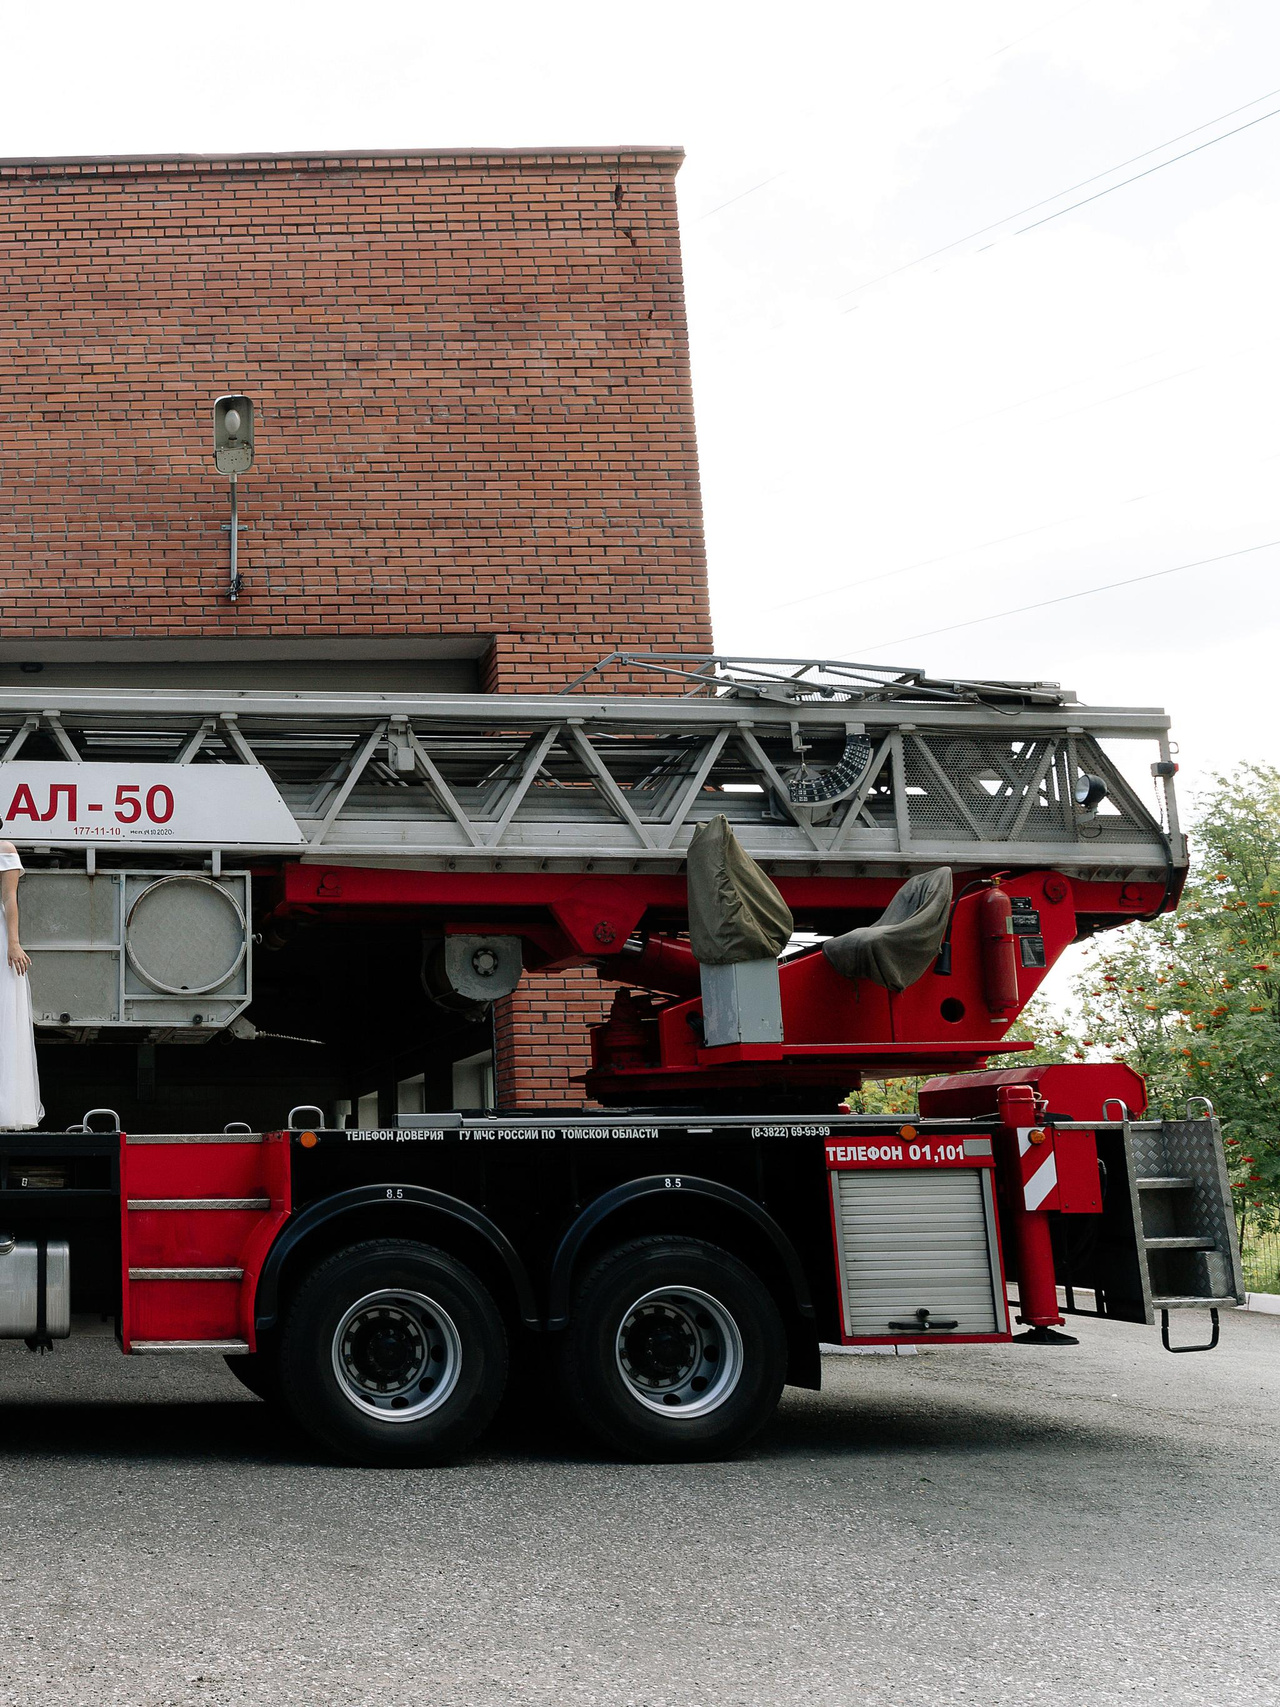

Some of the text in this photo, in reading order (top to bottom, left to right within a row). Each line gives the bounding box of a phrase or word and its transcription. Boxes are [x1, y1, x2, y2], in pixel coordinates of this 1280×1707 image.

[73, 827, 121, 836] 177-11-10
[346, 1131, 394, 1141] ТЕЛЕФОН
[396, 1131, 444, 1142] ДОВЕРИЯ
[459, 1130, 470, 1141] ГУ
[473, 1130, 495, 1140] МЧС
[498, 1129, 539, 1140] РОССИИ
[541, 1129, 556, 1139] ПО
[612, 1128, 659, 1139] ОБЛАСТИ
[751, 1127, 789, 1139] (8-3822)
[825, 1146, 904, 1162] ТЕЛЕФОН
[664, 1177, 682, 1188] 8.5
[386, 1188, 403, 1200] 8.5
